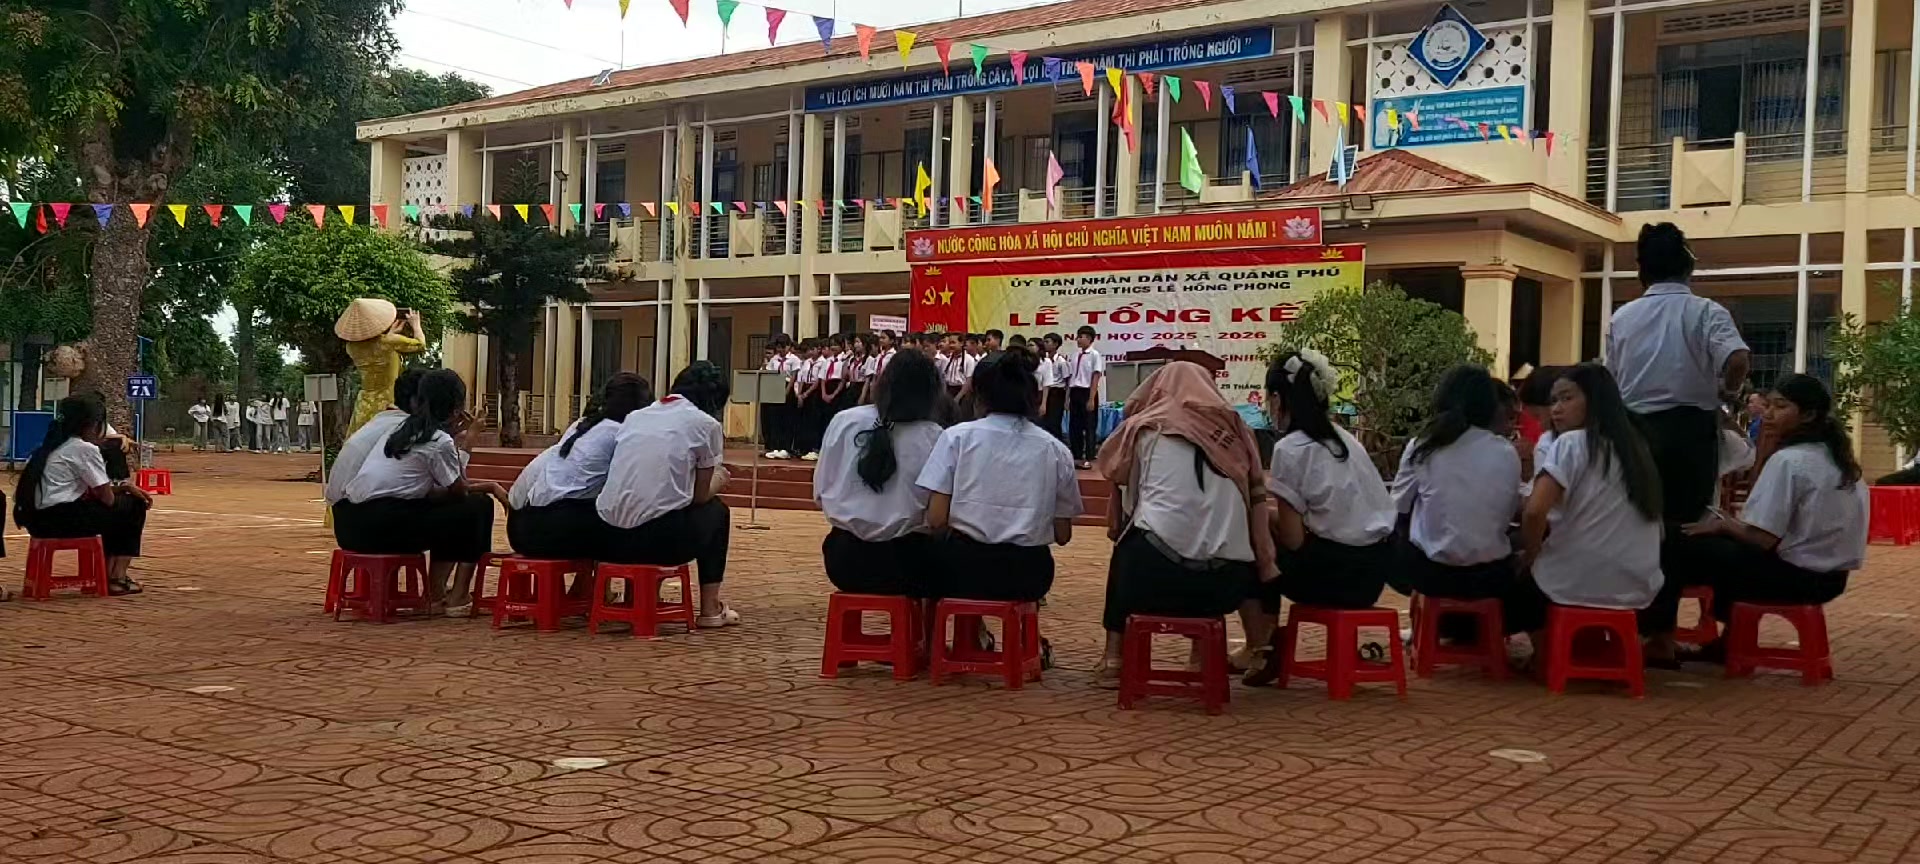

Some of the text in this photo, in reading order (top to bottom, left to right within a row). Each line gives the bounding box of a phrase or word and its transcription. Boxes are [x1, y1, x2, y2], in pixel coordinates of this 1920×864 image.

[826, 88, 835, 105] VÌ
[837, 88, 851, 106] LỢI
[853, 86, 867, 102] ÍCH
[870, 81, 891, 99] MƯỜI
[915, 76, 930, 96] THÌ
[1023, 63, 1039, 83] LỢI
[1093, 53, 1115, 71] NĂM
[1118, 48, 1136, 69] THÌ
[1138, 43, 1164, 67] PHẢI
[1167, 39, 1203, 63] TRỒNG
[1206, 35, 1242, 58] NGƯỜI
[937, 233, 966, 255] NƯỚC
[967, 233, 997, 254] CỘNG
[999, 231, 1022, 251] HÒA
[1024, 229, 1039, 250] XÃ
[1042, 228, 1063, 251] HỘI
[1065, 225, 1089, 247] CHỦ
[1092, 225, 1129, 247] NGHĨA
[1131, 223, 1159, 247] VIỆT
[1163, 225, 1191, 243] NAM
[1194, 219, 1233, 242] MUÔN
[1237, 219, 1268, 240] NĂM
[1010, 266, 1341, 288] ỦY BAN NHÂN DÂN XÃ QUẢNG PHÚ
[1050, 281, 1292, 297] TRƯỜNG THCS LÊ HỒNG PHONG
[1009, 300, 1307, 327] LỄ TỔNG KẾ
[1107, 332, 1145, 342] HỌC
[1151, 332, 1198, 340] 2025
[1218, 331, 1267, 340] 2026
[132, 385, 150, 396] 7A
